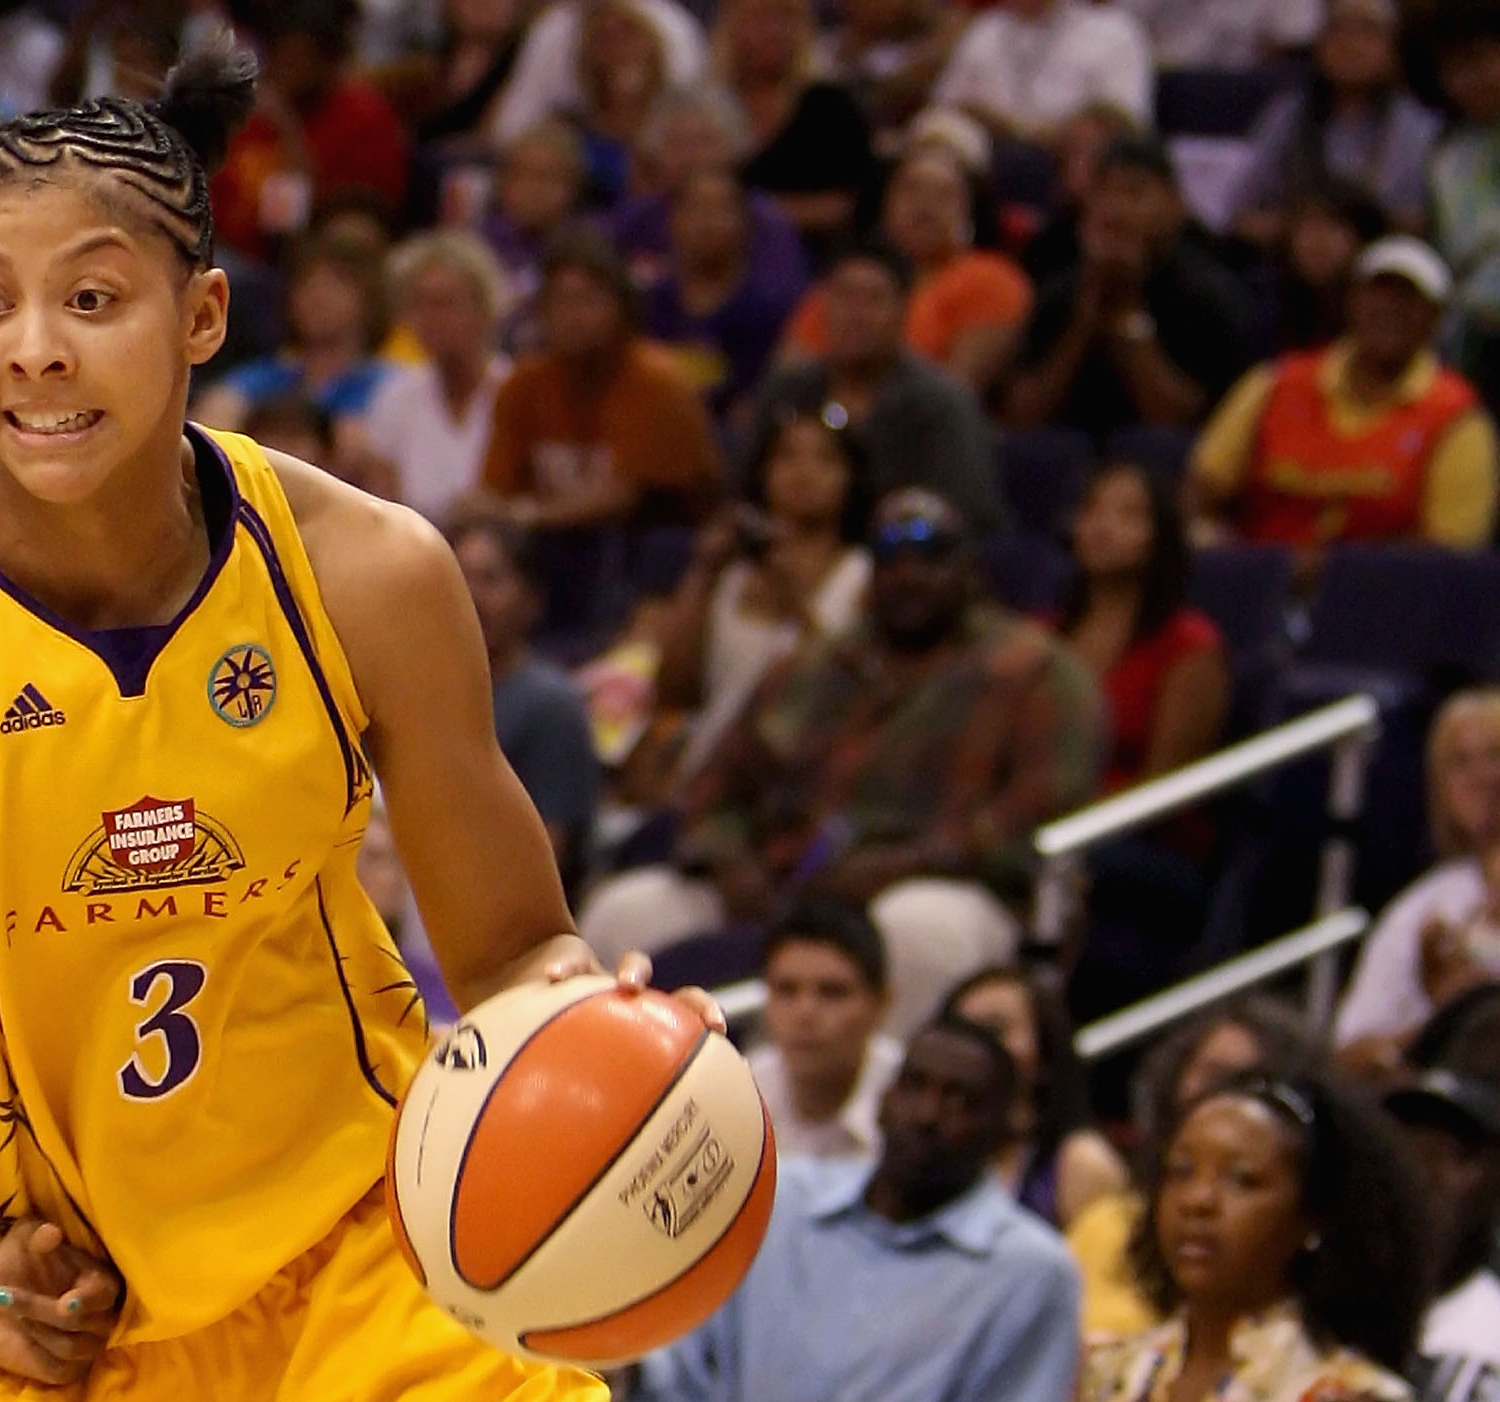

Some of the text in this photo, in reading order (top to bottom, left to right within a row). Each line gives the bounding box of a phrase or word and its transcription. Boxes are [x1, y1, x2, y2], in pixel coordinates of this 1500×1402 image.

[0, 711, 66, 734] adidas
[114, 804, 185, 831] FARMERS
[109, 822, 195, 851] INSURANCE
[128, 843, 180, 866] GROUP
[4, 858, 301, 950] FARMERS
[116, 956, 210, 1104] 3
